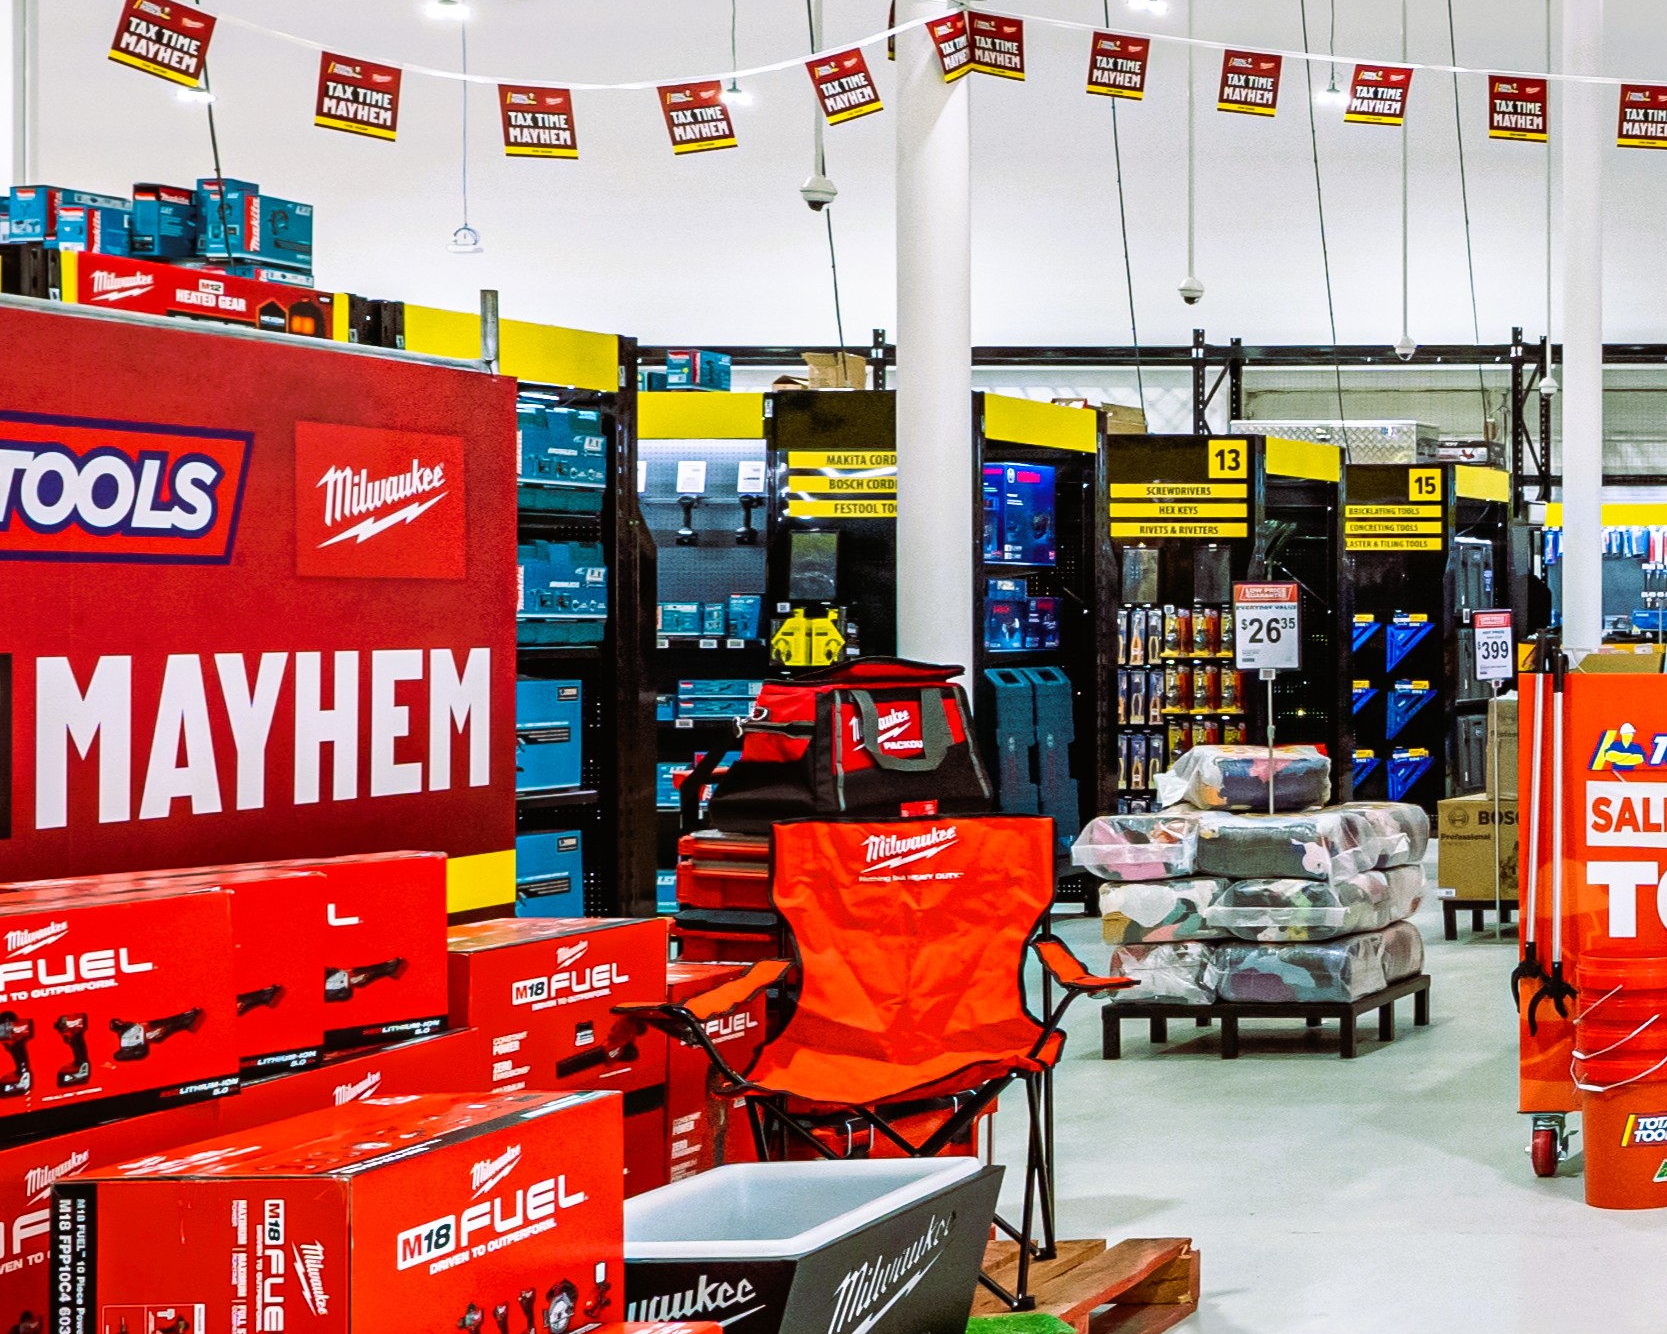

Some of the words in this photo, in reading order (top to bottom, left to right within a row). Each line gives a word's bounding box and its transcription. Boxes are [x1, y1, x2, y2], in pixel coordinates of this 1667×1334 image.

[128, 16, 161, 42] TAX
[162, 26, 201, 55] TIME
[120, 31, 198, 74] MAYHEM
[820, 79, 842, 97] TAX
[840, 72, 869, 93] TIME
[824, 85, 875, 113] MAYHEM
[90, 270, 154, 293] Milwaukee
[176, 290, 215, 308] HEATED
[218, 293, 246, 311] GEAR
[826, 455, 866, 466] MAKITA
[1215, 449, 1241, 471] 13
[316, 457, 447, 527] Milwaukee
[829, 479, 861, 490] BOSCH
[864, 479, 897, 490] CORD
[1145, 486, 1212, 497] SCREWDRIVERS
[1414, 476, 1436, 495] 15
[834, 503, 875, 514] FESTOOL
[1158, 506, 1174, 515] HEX
[1177, 505, 1198, 516] KEYS
[1348, 507, 1396, 515] BRICKLAYING
[1397, 507, 1420, 515] TOOLS
[1139, 524, 1167, 536] RIVETS
[1169, 525, 1178, 536] &
[1179, 524, 1219, 536] RIVETERS
[1350, 524, 1395, 532] CONCRETING
[1345, 540, 1369, 548] LASTER
[1380, 540, 1403, 548] TILING
[1405, 540, 1428, 548] TOOLS
[35, 647, 491, 829] MAYHEM
[861, 826, 956, 862] Milwaukee
[4, 920, 69, 952] Milwaukee
[0, 948, 153, 991] FUEL
[515, 981, 545, 1001] M18
[550, 963, 629, 997] FUEL
[12, 991, 28, 1001] TO
[471, 1144, 521, 1190] Milwaukee
[58, 1199, 71, 1231] M18
[268, 1203, 281, 1241] M18
[402, 1224, 451, 1260] M18
[461, 1175, 585, 1248] FUEL
[430, 1250, 469, 1275] DRIVEN
[472, 1243, 486, 1257] TO
[76, 1276, 85, 1306] Piece
[299, 1239, 328, 1316] Milwaukee
